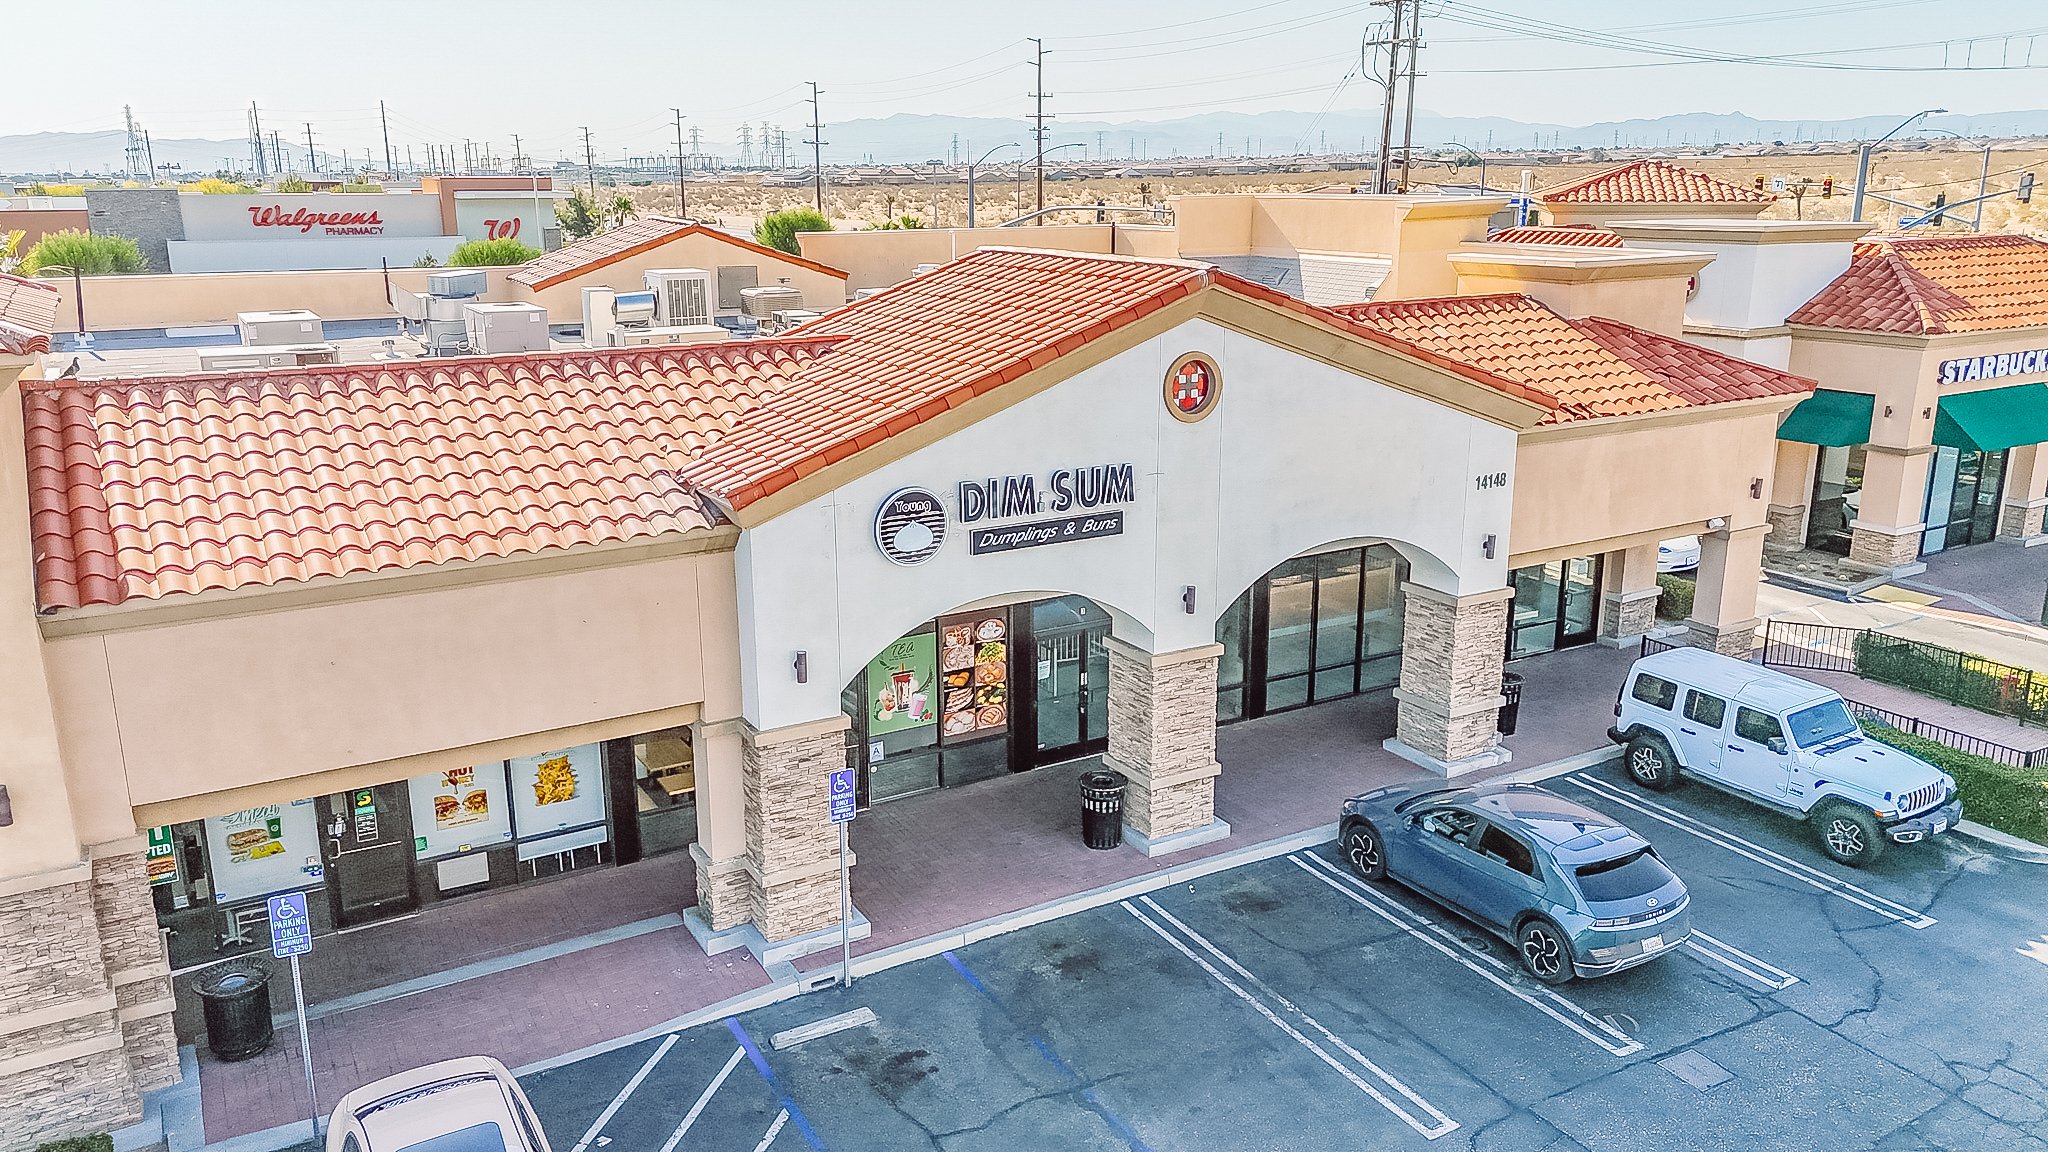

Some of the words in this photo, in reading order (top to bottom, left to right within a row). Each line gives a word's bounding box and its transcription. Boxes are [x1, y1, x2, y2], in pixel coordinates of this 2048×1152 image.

[248, 204, 384, 233] Walgreens
[325, 226, 384, 236] PHARMACY
[1937, 348, 2048, 385] STARBUCK
[1475, 472, 1507, 491] 14148
[958, 474, 1036, 523] DIM
[1050, 463, 1135, 513] SUM
[894, 500, 932, 513] Young
[978, 526, 1057, 548] Dumplings
[1063, 521, 1076, 536] &
[1082, 516, 1119, 533] Buns
[890, 641, 915, 656] TEA
[273, 916, 306, 930] PARKING
[281, 926, 301, 938] ONLY
